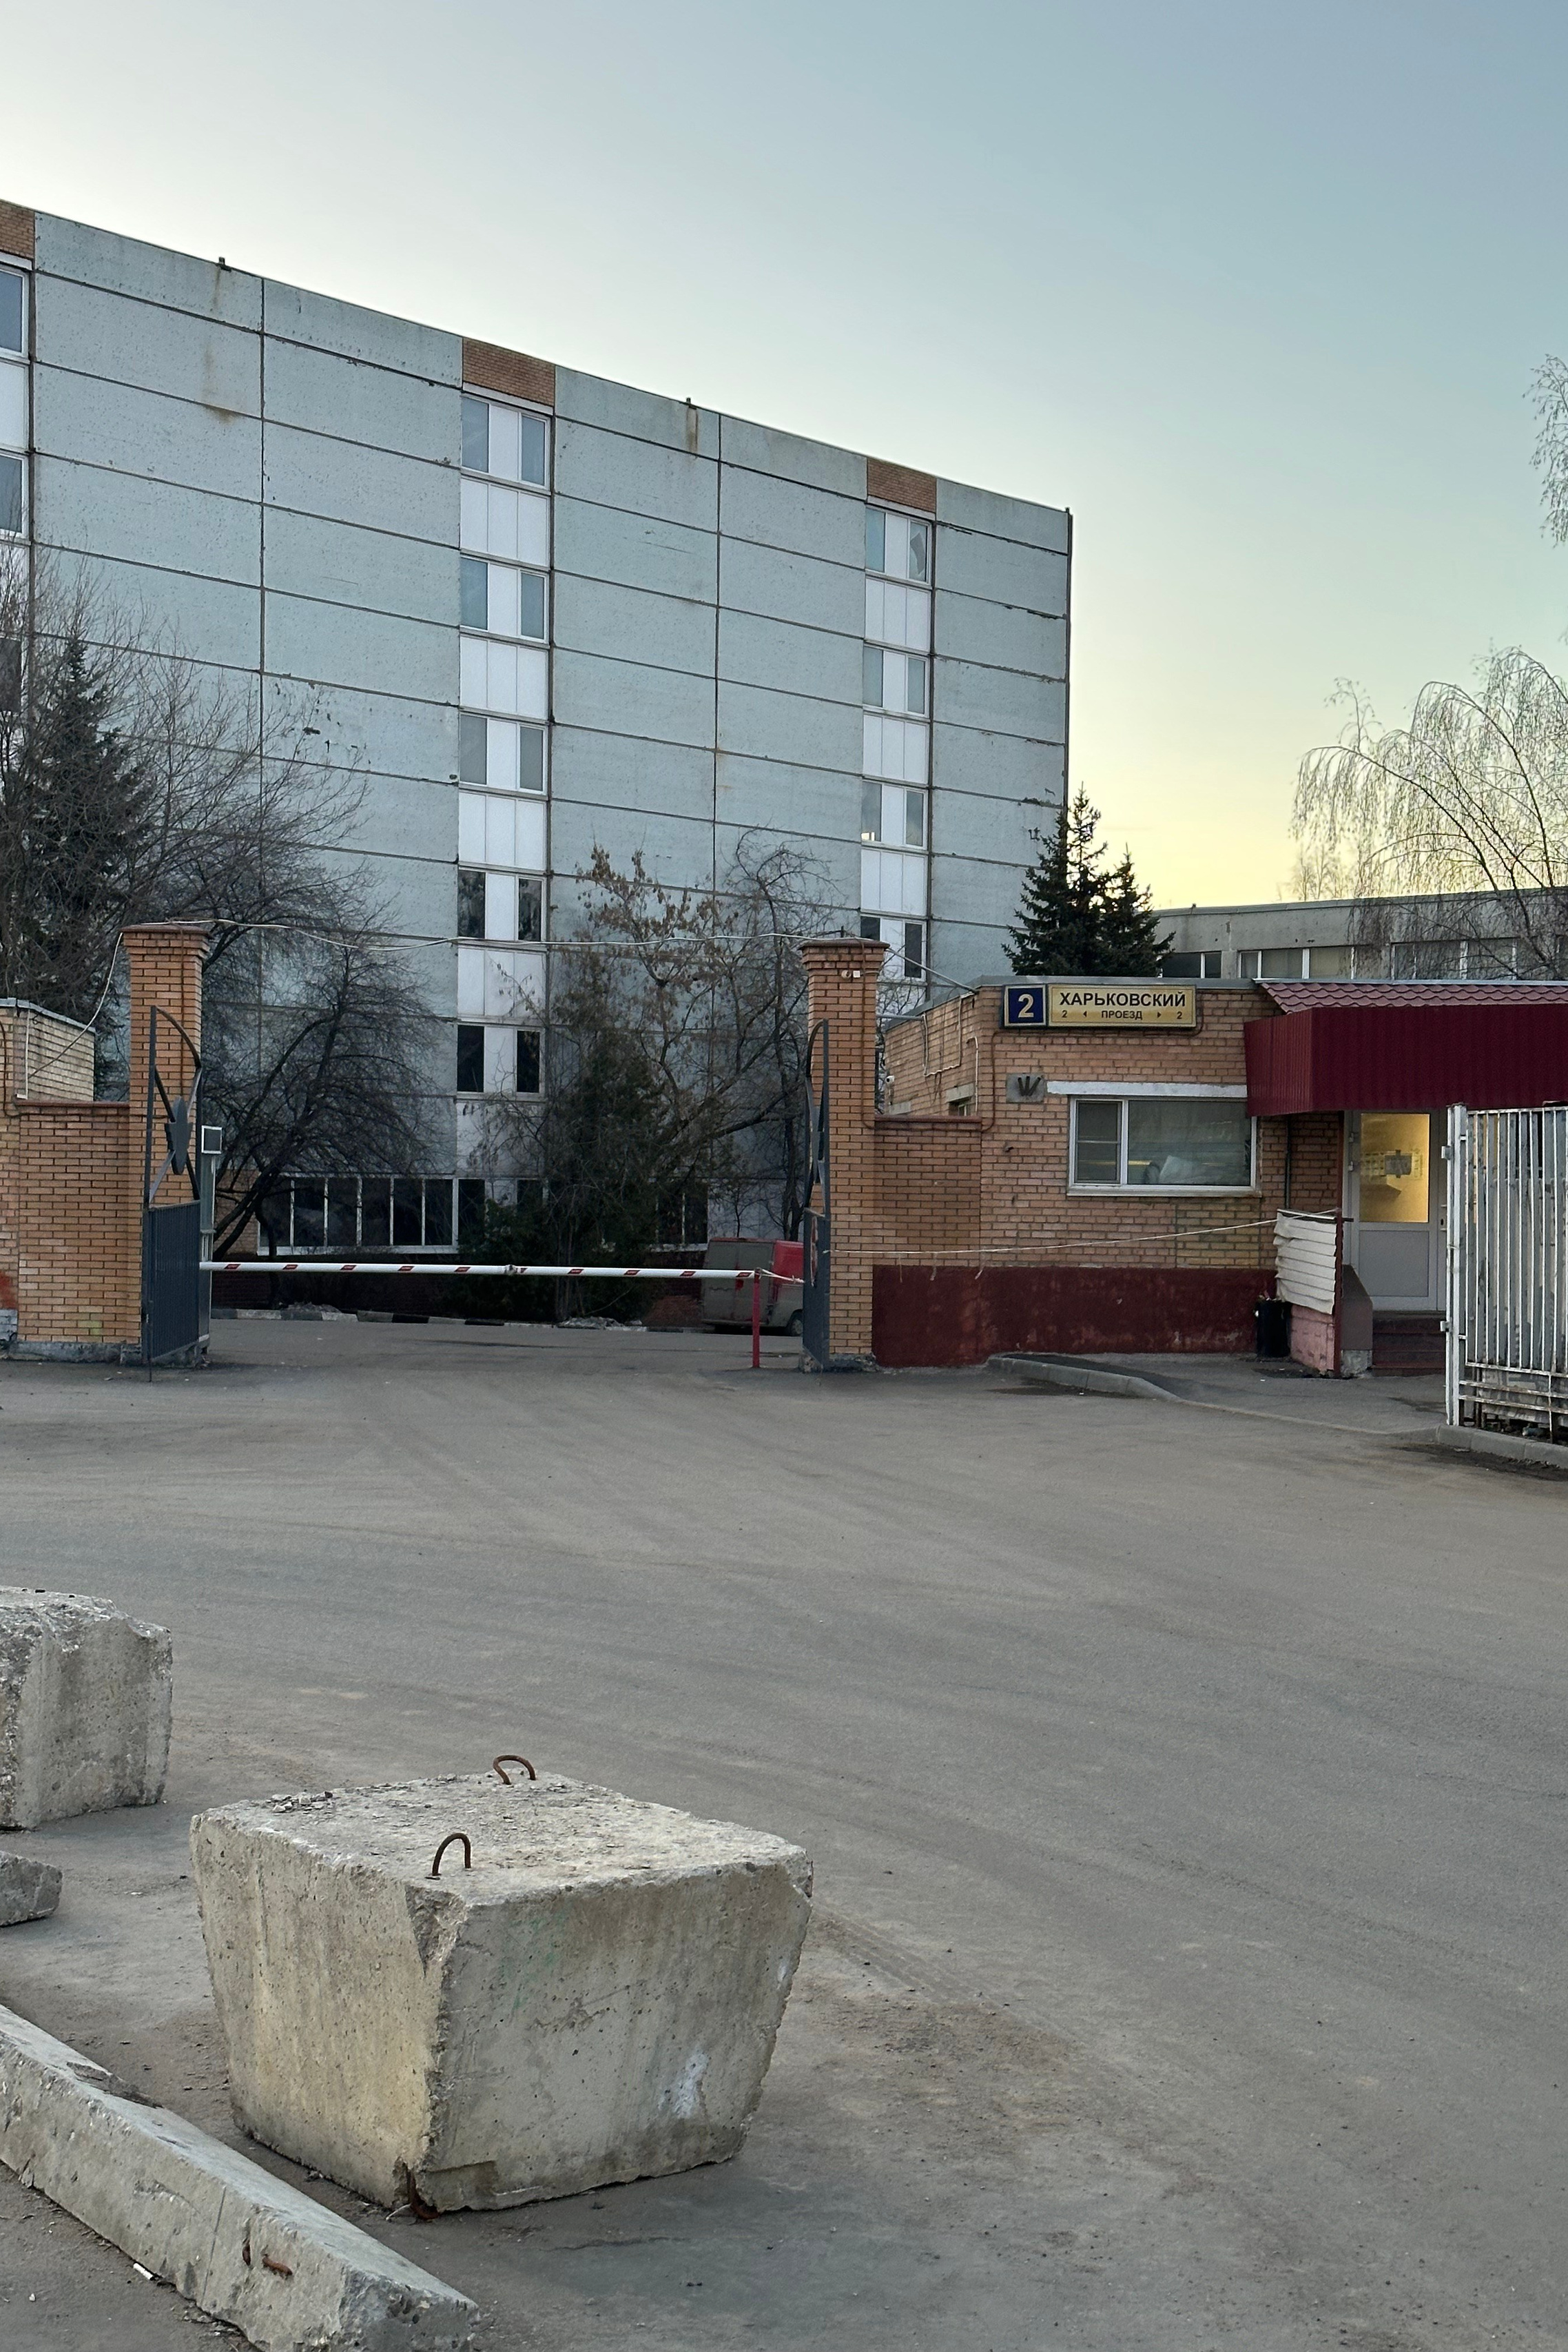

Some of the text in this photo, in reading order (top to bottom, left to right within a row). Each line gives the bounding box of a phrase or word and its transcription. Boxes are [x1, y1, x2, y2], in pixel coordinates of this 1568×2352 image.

[1018, 994, 1033, 1018] 2
[1060, 991, 1185, 1007] ХАРЬКОВСКИЙ
[1101, 1010, 1142, 1020] ПРОЕЗД
